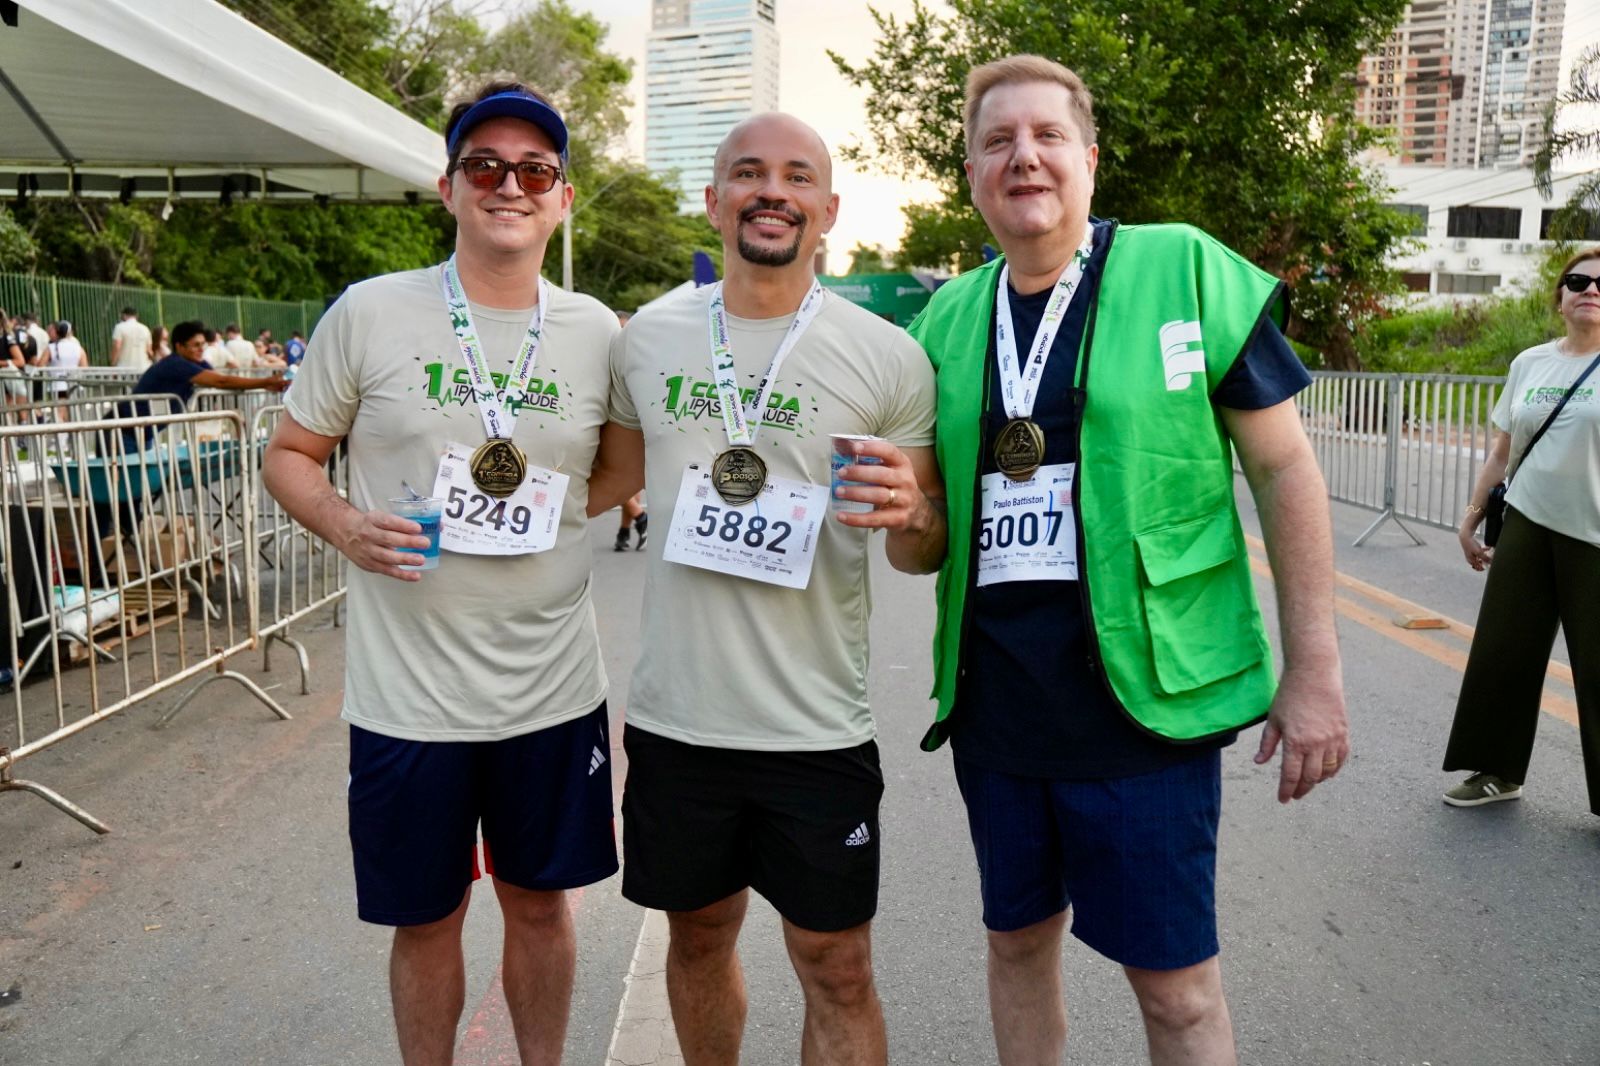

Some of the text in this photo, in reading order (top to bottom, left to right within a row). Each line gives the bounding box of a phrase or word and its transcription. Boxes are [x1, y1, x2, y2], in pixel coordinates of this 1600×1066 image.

[445, 486, 531, 535] 5249
[993, 496, 1044, 509] Paulo Battiston
[695, 505, 792, 555] 5882
[979, 511, 1063, 551] 5007
